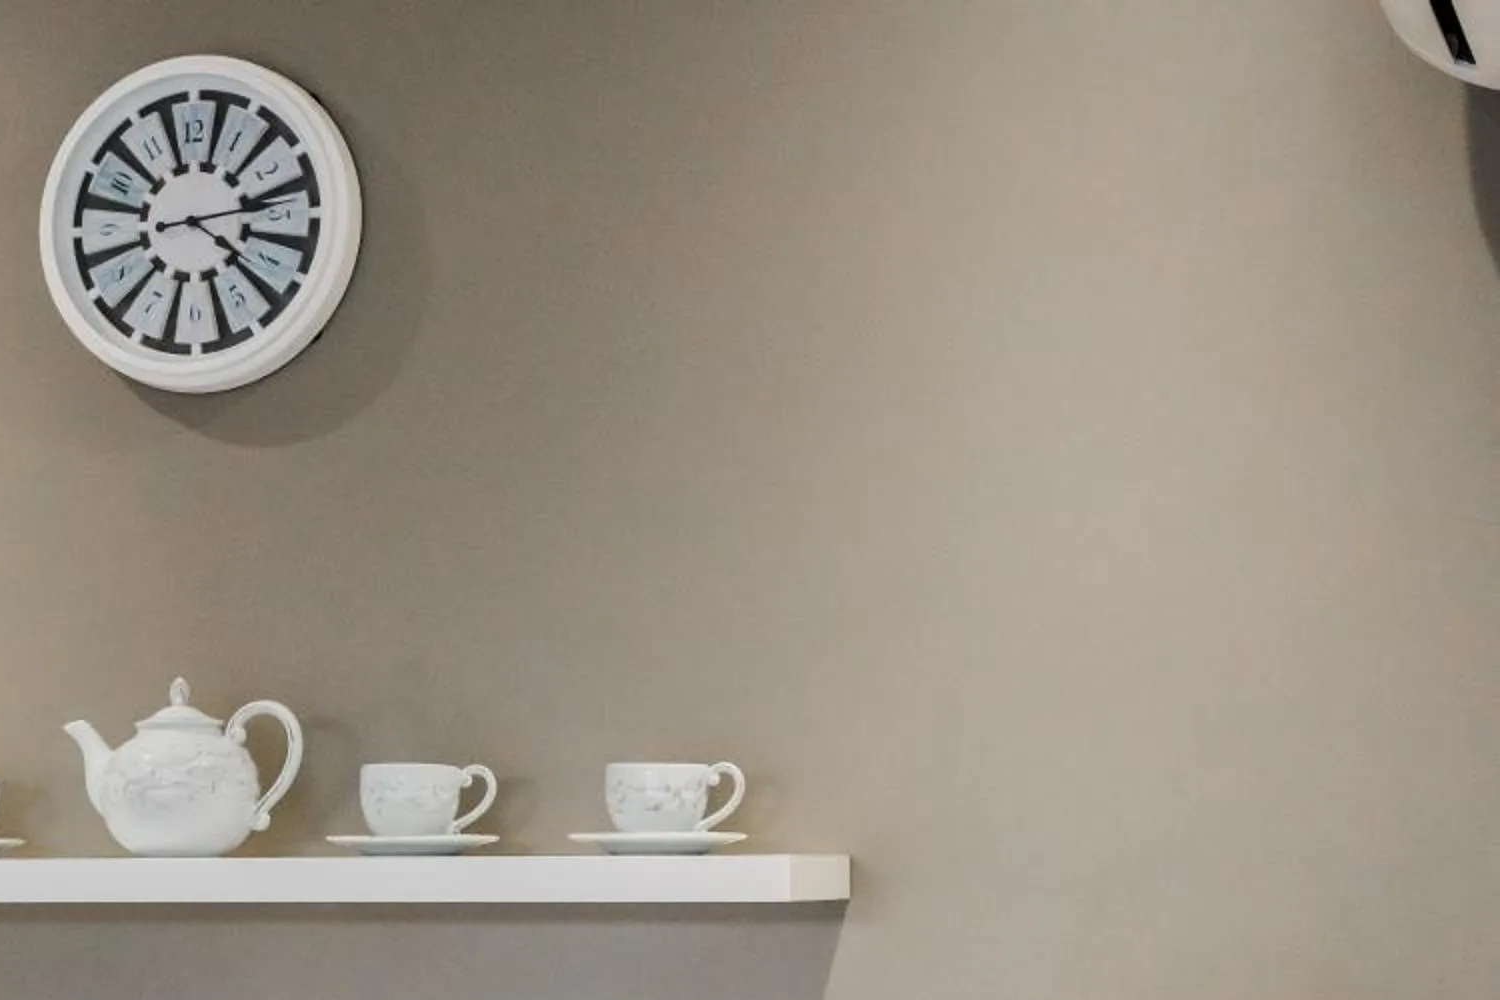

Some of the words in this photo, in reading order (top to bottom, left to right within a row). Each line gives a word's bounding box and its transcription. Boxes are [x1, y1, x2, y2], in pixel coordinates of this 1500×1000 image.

[183, 119, 204, 144] 12
[228, 131, 243, 152] 1
[110, 171, 133, 196] 10
